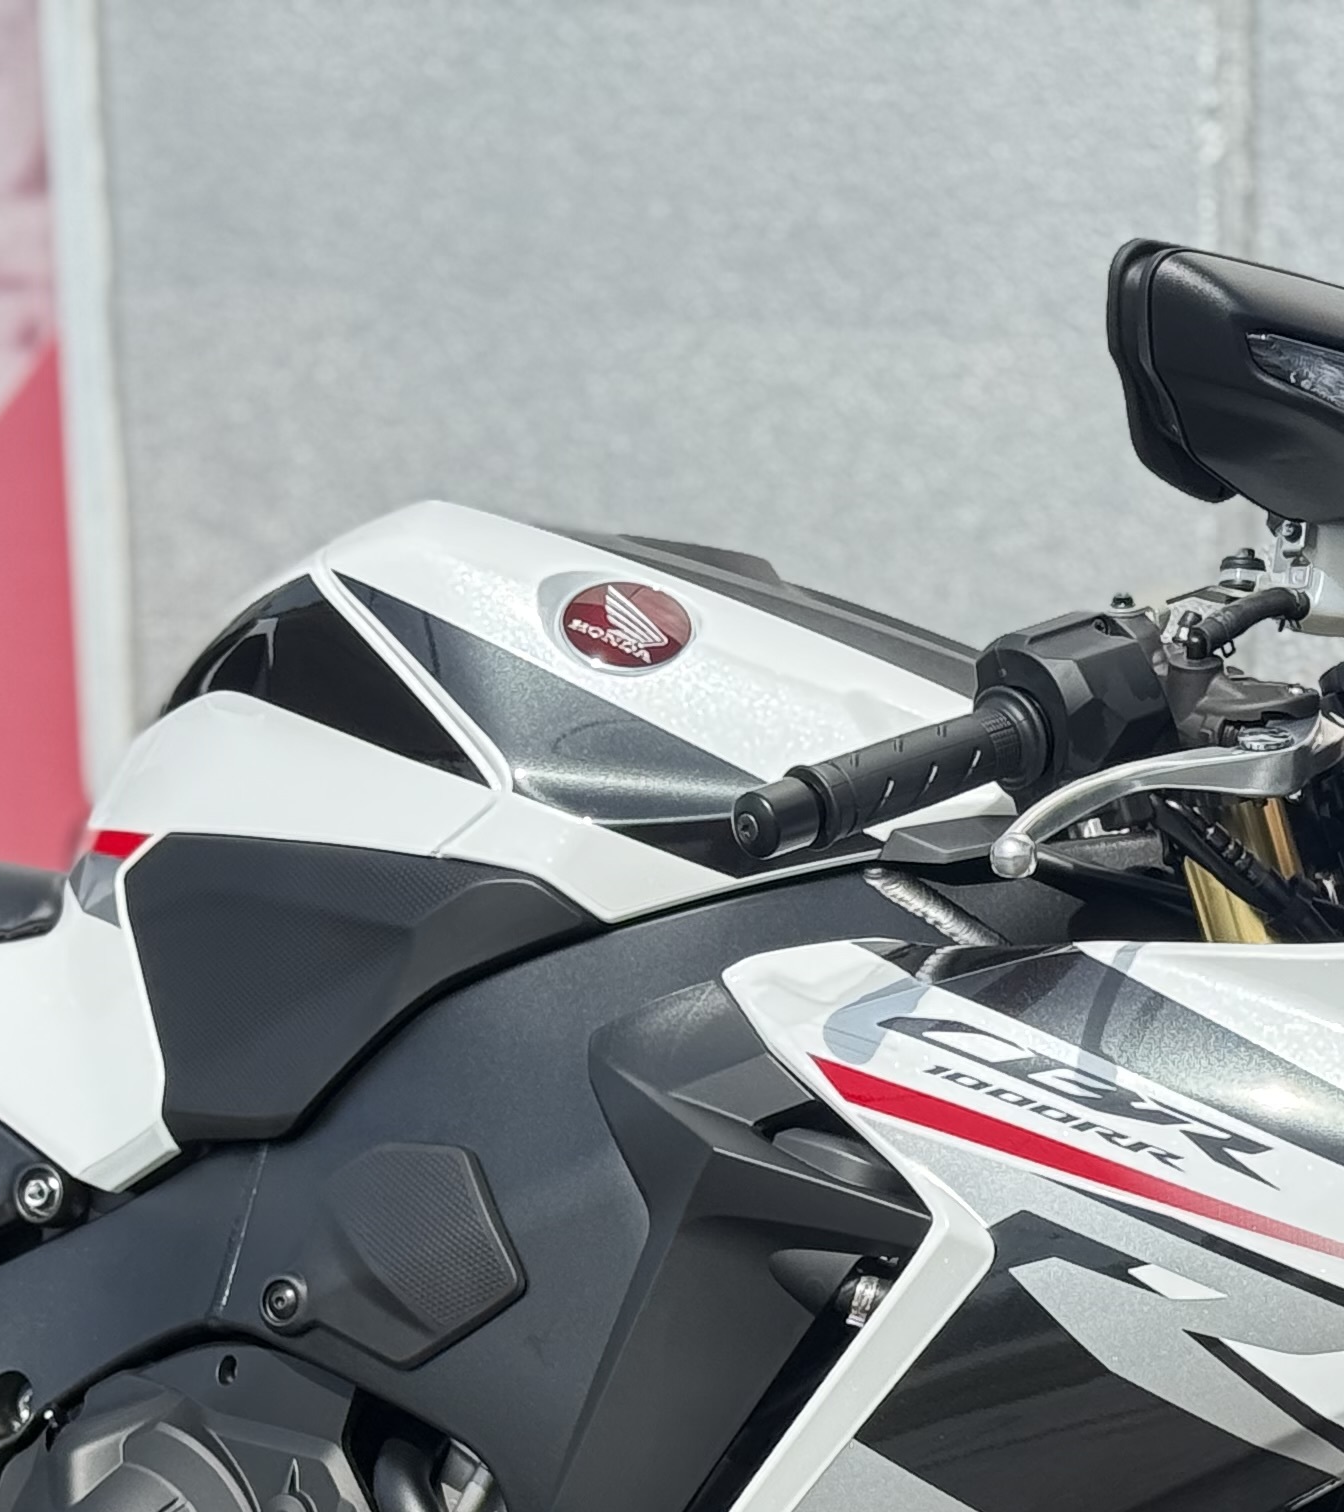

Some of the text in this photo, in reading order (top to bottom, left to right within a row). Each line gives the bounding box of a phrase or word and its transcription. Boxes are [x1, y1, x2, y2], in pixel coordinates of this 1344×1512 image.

[568, 617, 653, 664] HONDA
[876, 1015, 1281, 1191] CBR
[922, 1064, 1186, 1173] 1000RR
